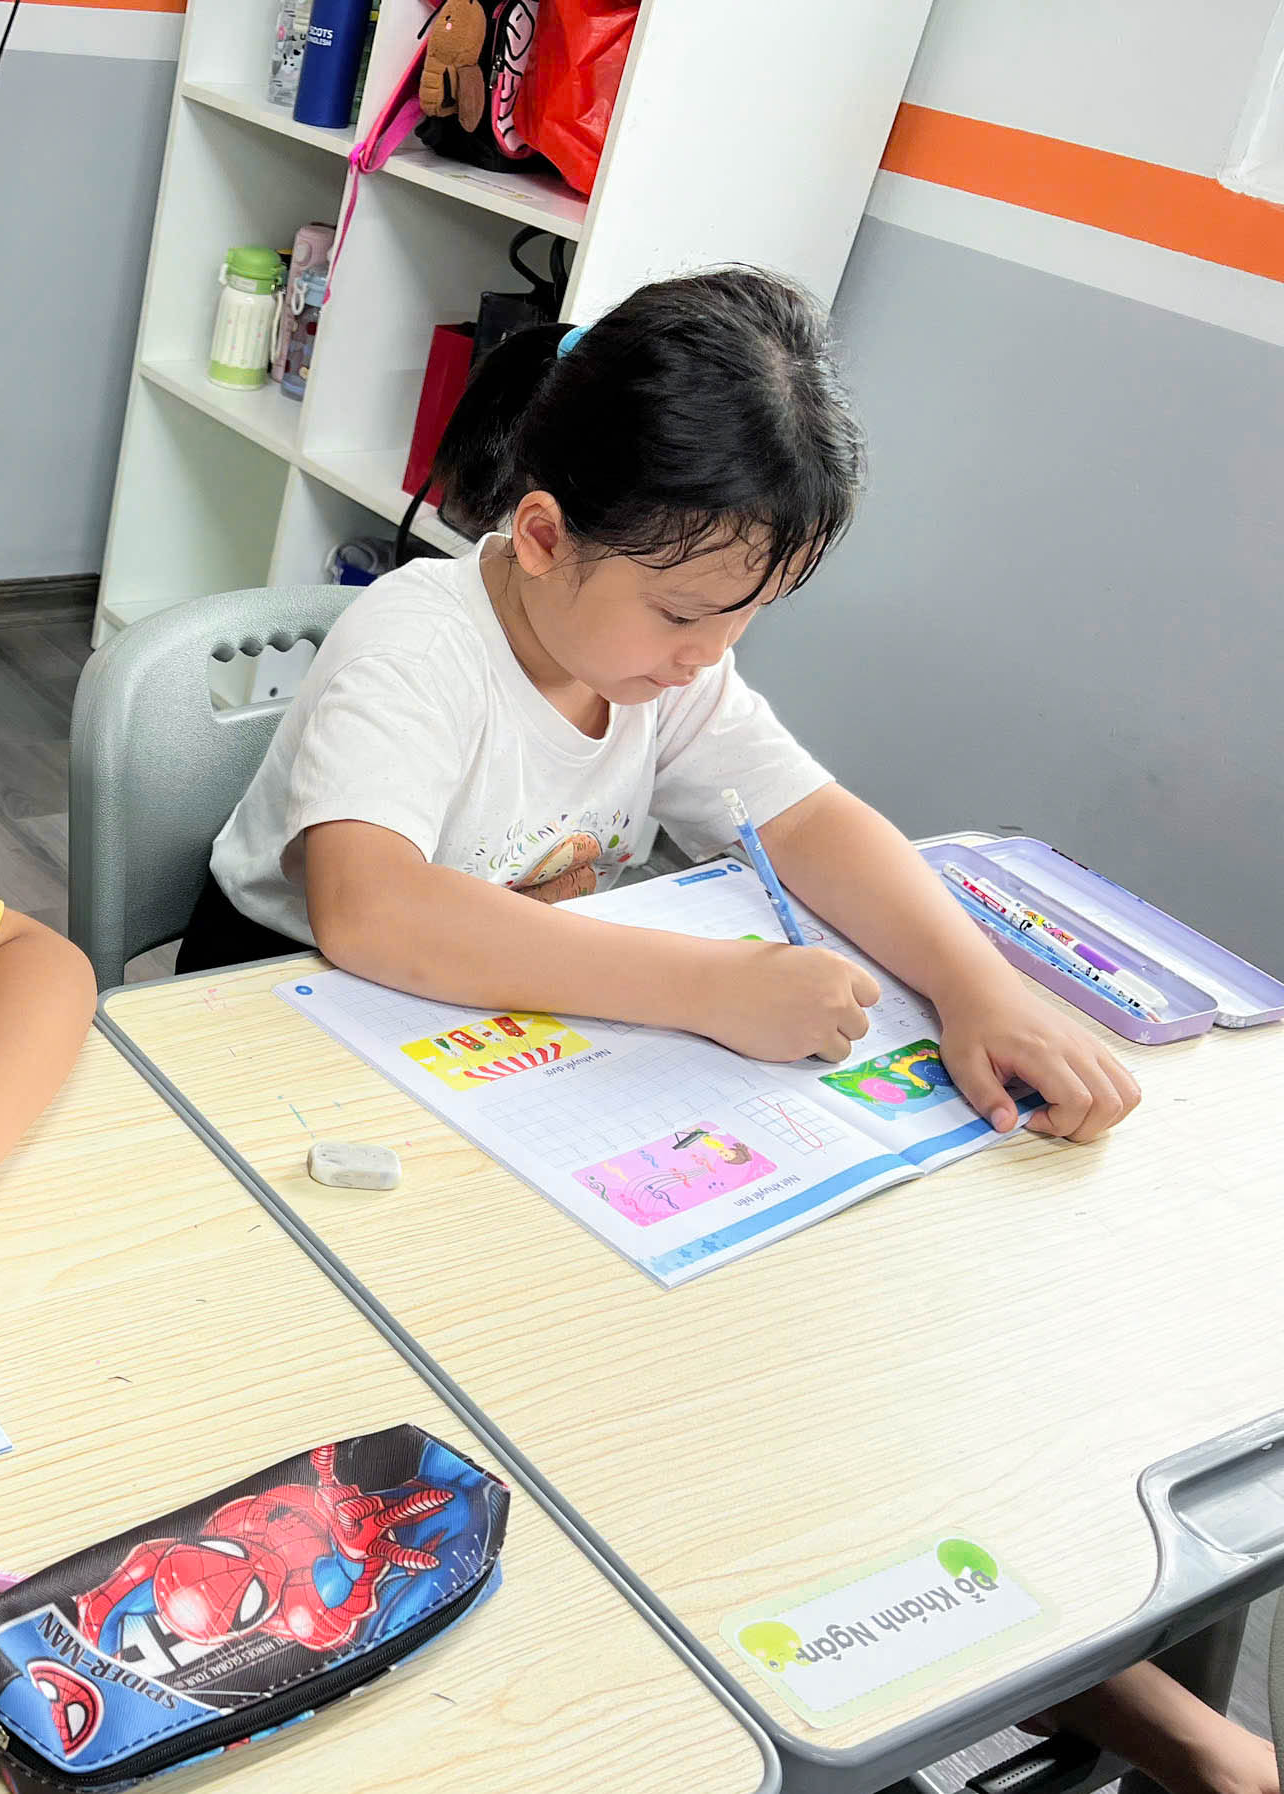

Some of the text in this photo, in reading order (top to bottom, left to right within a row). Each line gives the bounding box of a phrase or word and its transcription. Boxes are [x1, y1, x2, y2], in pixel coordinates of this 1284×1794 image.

[871, 1587, 960, 1633] Khánh
[241, 1640, 276, 1662] HEROES
[796, 1623, 878, 1665] Ngân
[36, 1612, 181, 1711] SPIDER-MAN
[208, 1654, 243, 1677] GLOBAL
[183, 1670, 211, 1688] TOUR
